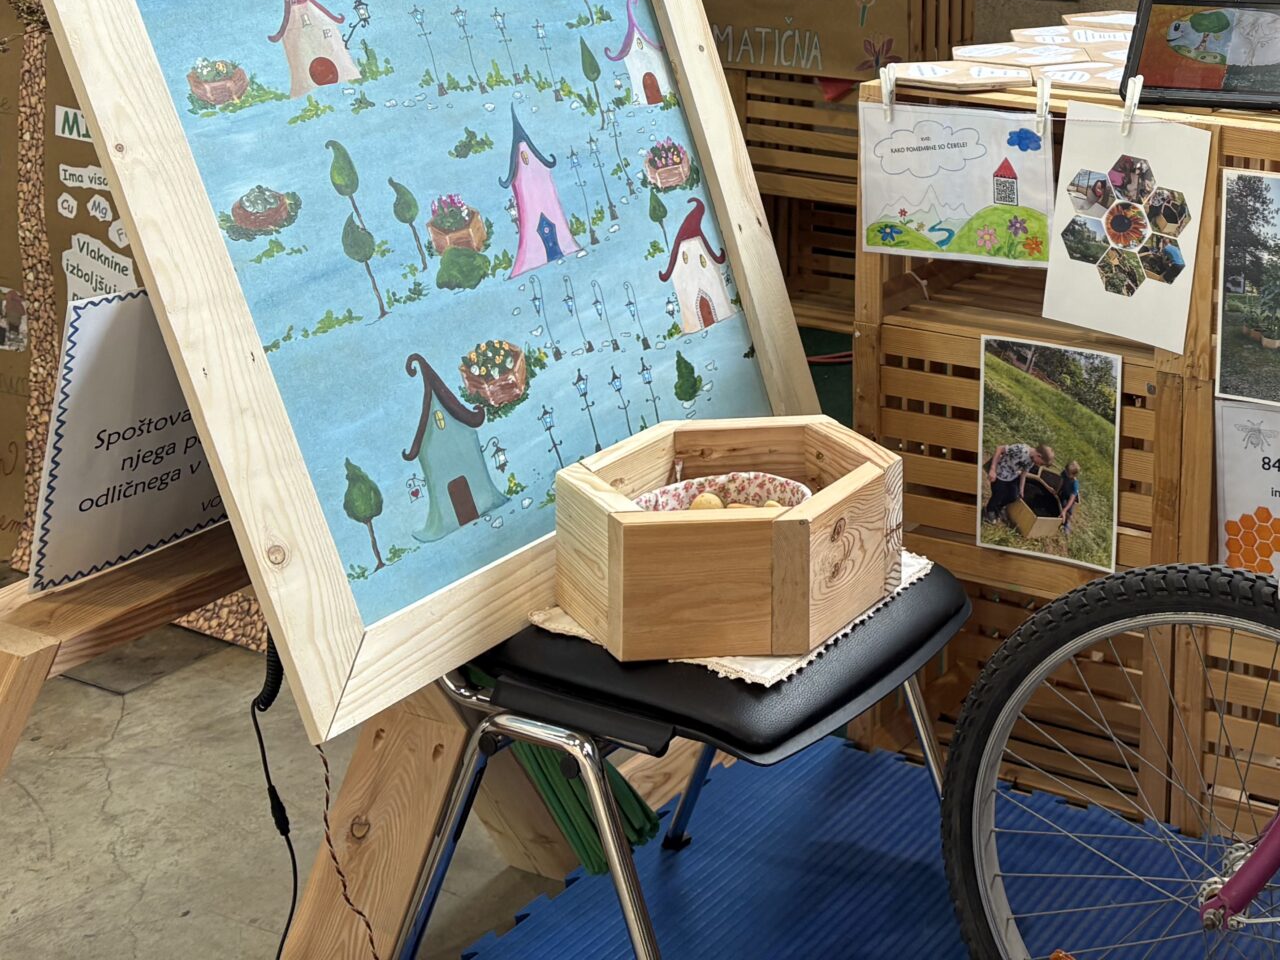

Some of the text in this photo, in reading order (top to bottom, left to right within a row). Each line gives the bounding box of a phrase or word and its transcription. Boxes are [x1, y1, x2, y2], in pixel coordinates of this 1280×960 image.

[711, 15, 824, 71] MATIČNA
[61, 168, 84, 184] Ima
[60, 198, 109, 219] Cu Mg
[76, 237, 130, 277] Vlaknine
[64, 259, 122, 296] izboljšuj
[93, 408, 193, 452] Spoštova
[120, 440, 177, 472] njega
[78, 460, 202, 513] odličnega v
